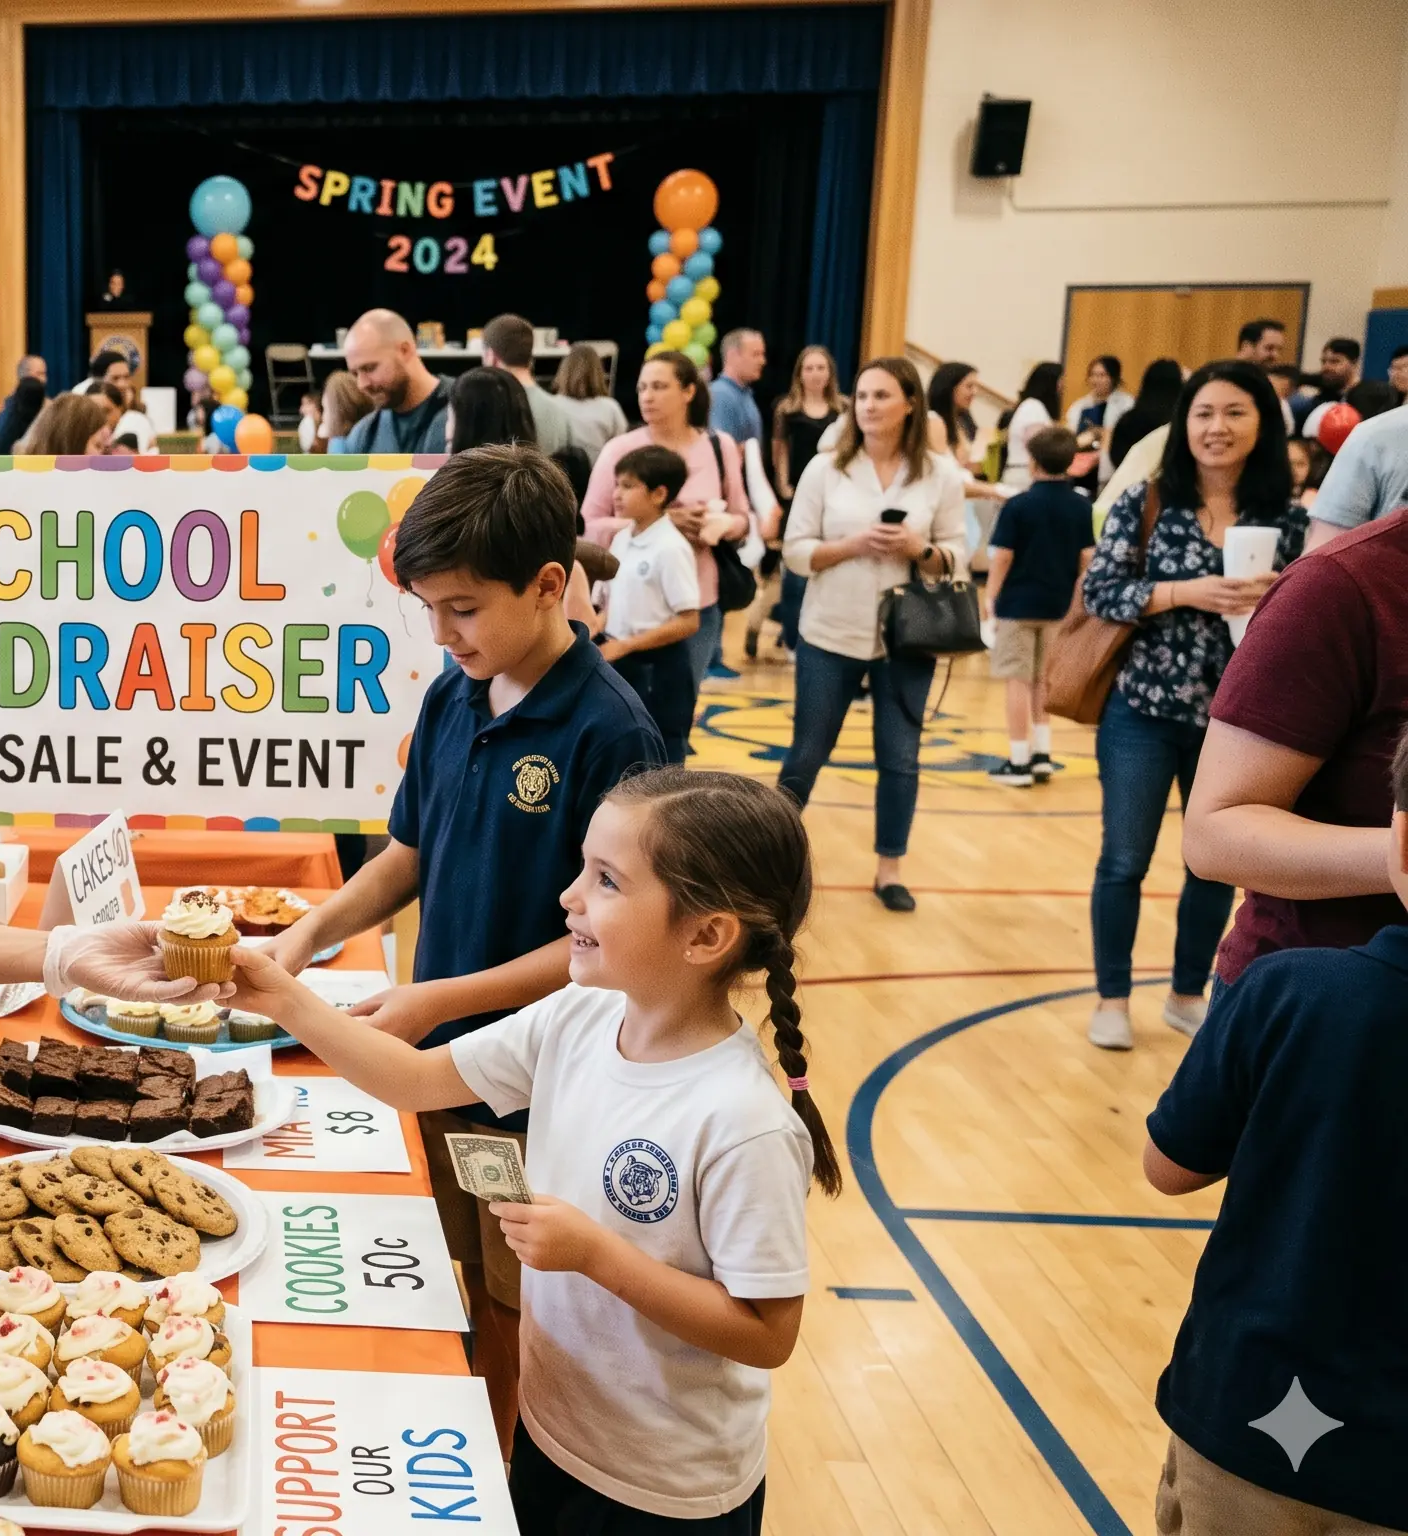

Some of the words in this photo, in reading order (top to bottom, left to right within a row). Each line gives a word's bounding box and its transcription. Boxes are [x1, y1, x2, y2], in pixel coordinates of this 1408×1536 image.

[294, 164, 454, 219] SPRING
[473, 152, 615, 217] EVENT
[384, 233, 498, 274] 2024
[142, 735, 176, 787] &
[197, 738, 366, 789] EVENT
[71, 839, 114, 904] CAKES
[325, 1111, 379, 1135] $8
[282, 1205, 348, 1314] COOKIES
[351, 1445, 395, 1495] OUR
[402, 1428, 482, 1521] KIDS
